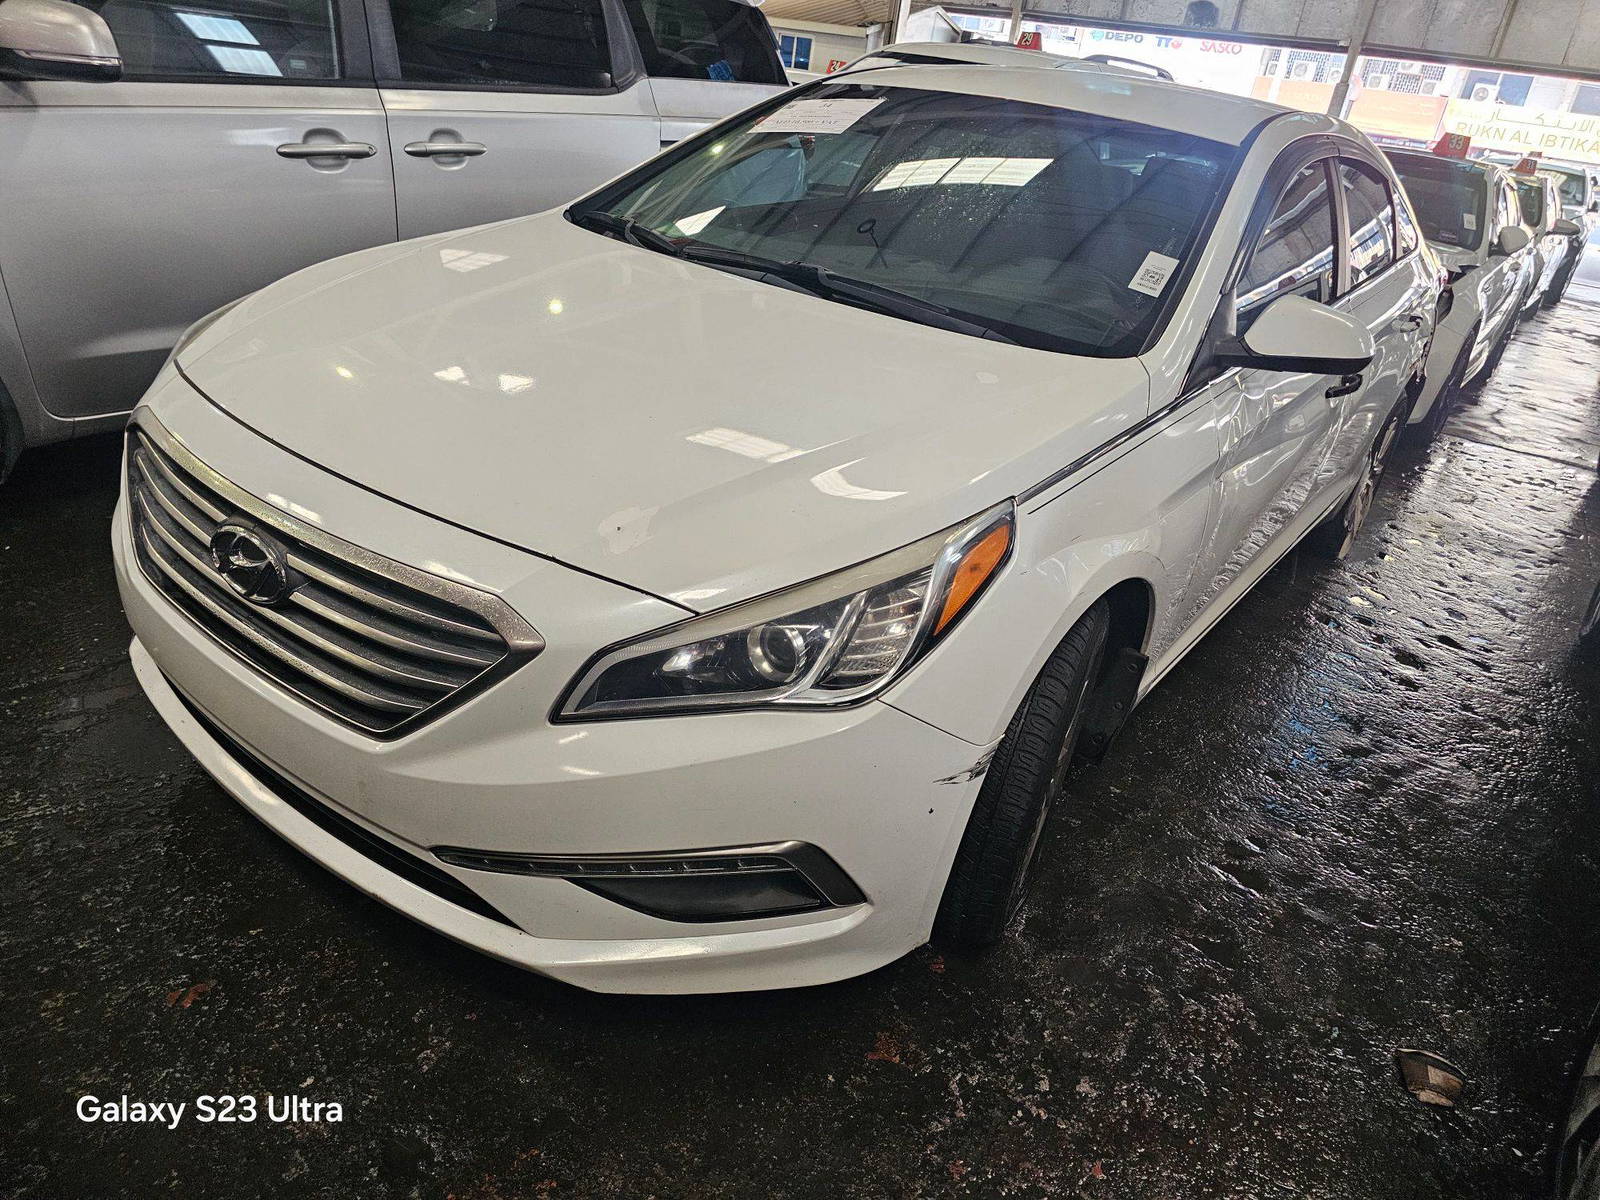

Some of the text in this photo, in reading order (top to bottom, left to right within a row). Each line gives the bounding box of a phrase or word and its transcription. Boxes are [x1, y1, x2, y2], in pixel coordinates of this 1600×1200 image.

[1021, 33, 1033, 46] 29
[1105, 31, 1143, 44] DEPO
[1200, 40, 1243, 55] SASCO
[1456, 121, 1505, 142] RUKN
[1509, 128, 1532, 145] AL
[1449, 133, 1464, 150] 33
